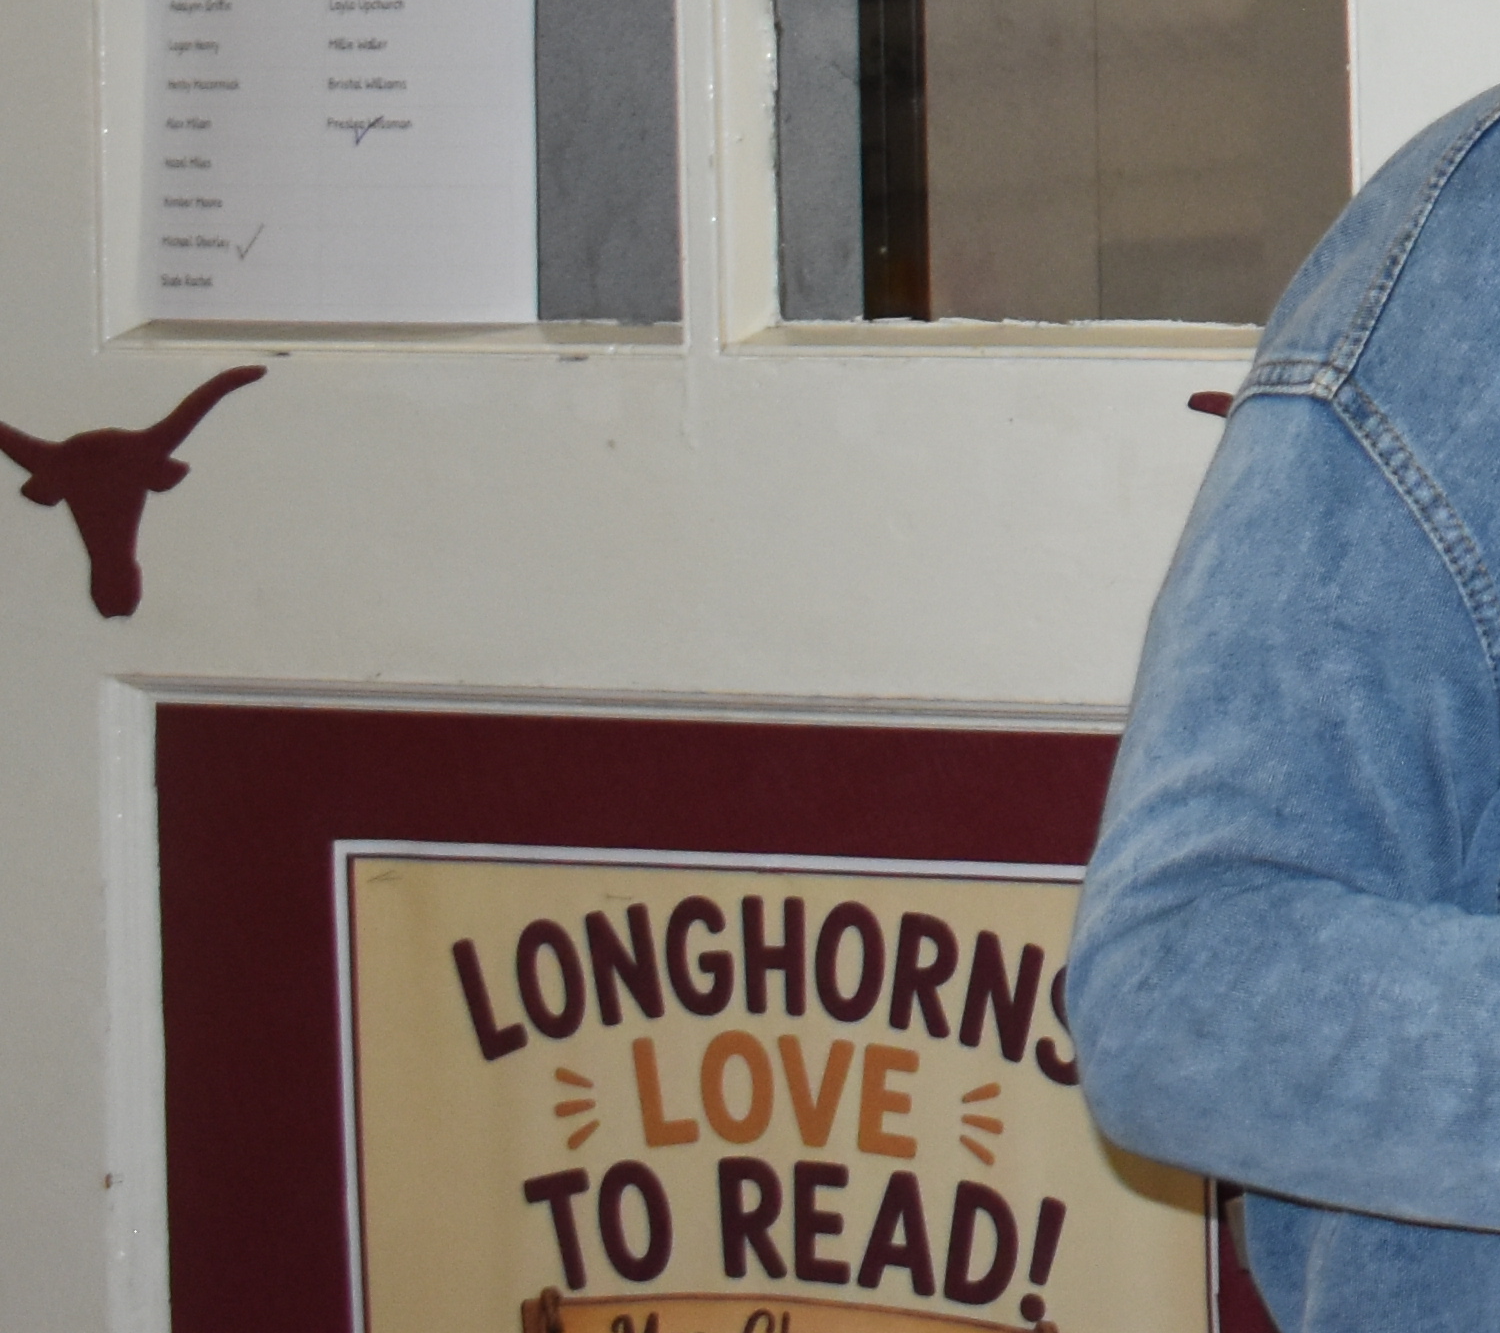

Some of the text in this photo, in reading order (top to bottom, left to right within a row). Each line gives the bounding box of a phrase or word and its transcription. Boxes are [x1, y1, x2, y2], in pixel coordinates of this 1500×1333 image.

[632, 1029, 920, 1159] LOVE
[523, 1155, 1068, 1323] TO READ!
